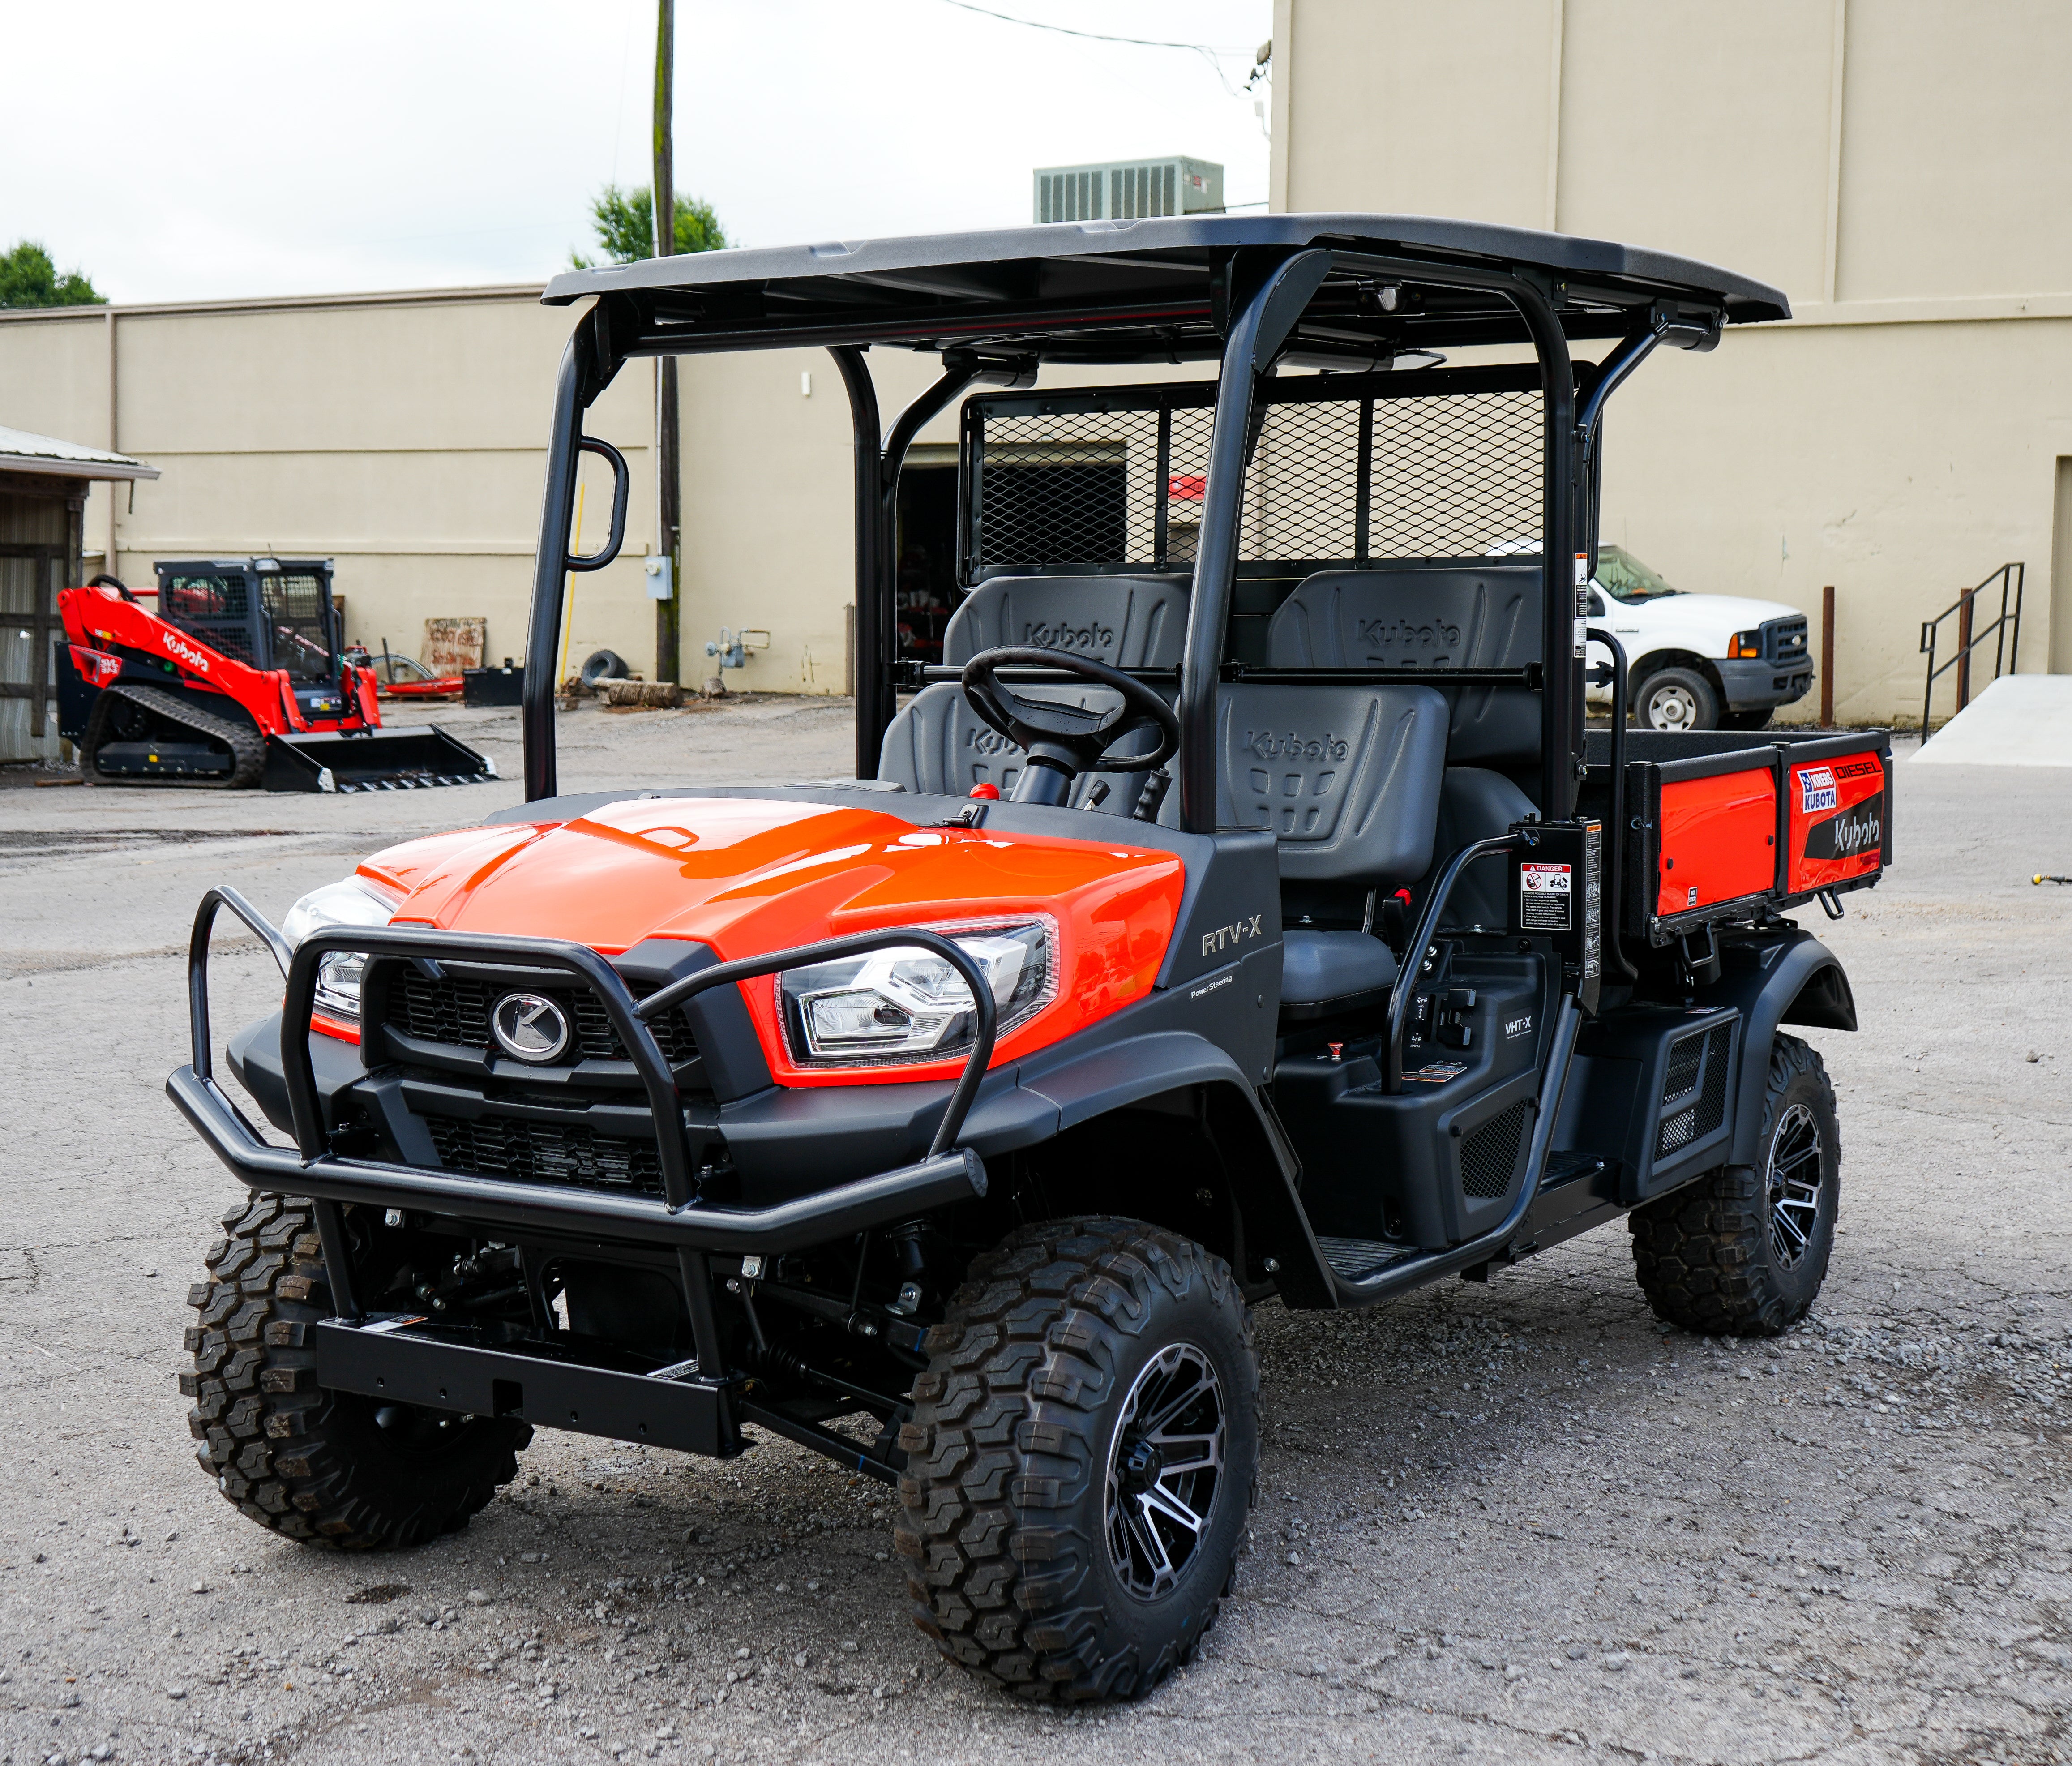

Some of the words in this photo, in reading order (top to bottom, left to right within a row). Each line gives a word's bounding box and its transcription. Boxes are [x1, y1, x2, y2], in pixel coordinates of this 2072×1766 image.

[1024, 621, 1114, 648] Kubota
[1358, 617, 1461, 646] Kubota
[162, 630, 209, 672] Kubota
[1243, 730, 1349, 761] Kubota
[1810, 771, 1834, 788] KREBS
[1834, 761, 1883, 779] DIESEL
[1805, 790, 1836, 810] KUBOTA
[1835, 812, 1879, 851] Kubota
[1202, 914, 1262, 956] RTV-X
[1191, 986, 1209, 999] Power
[1209, 975, 1232, 990] Steering
[1505, 1016, 1531, 1034] VHT-X
